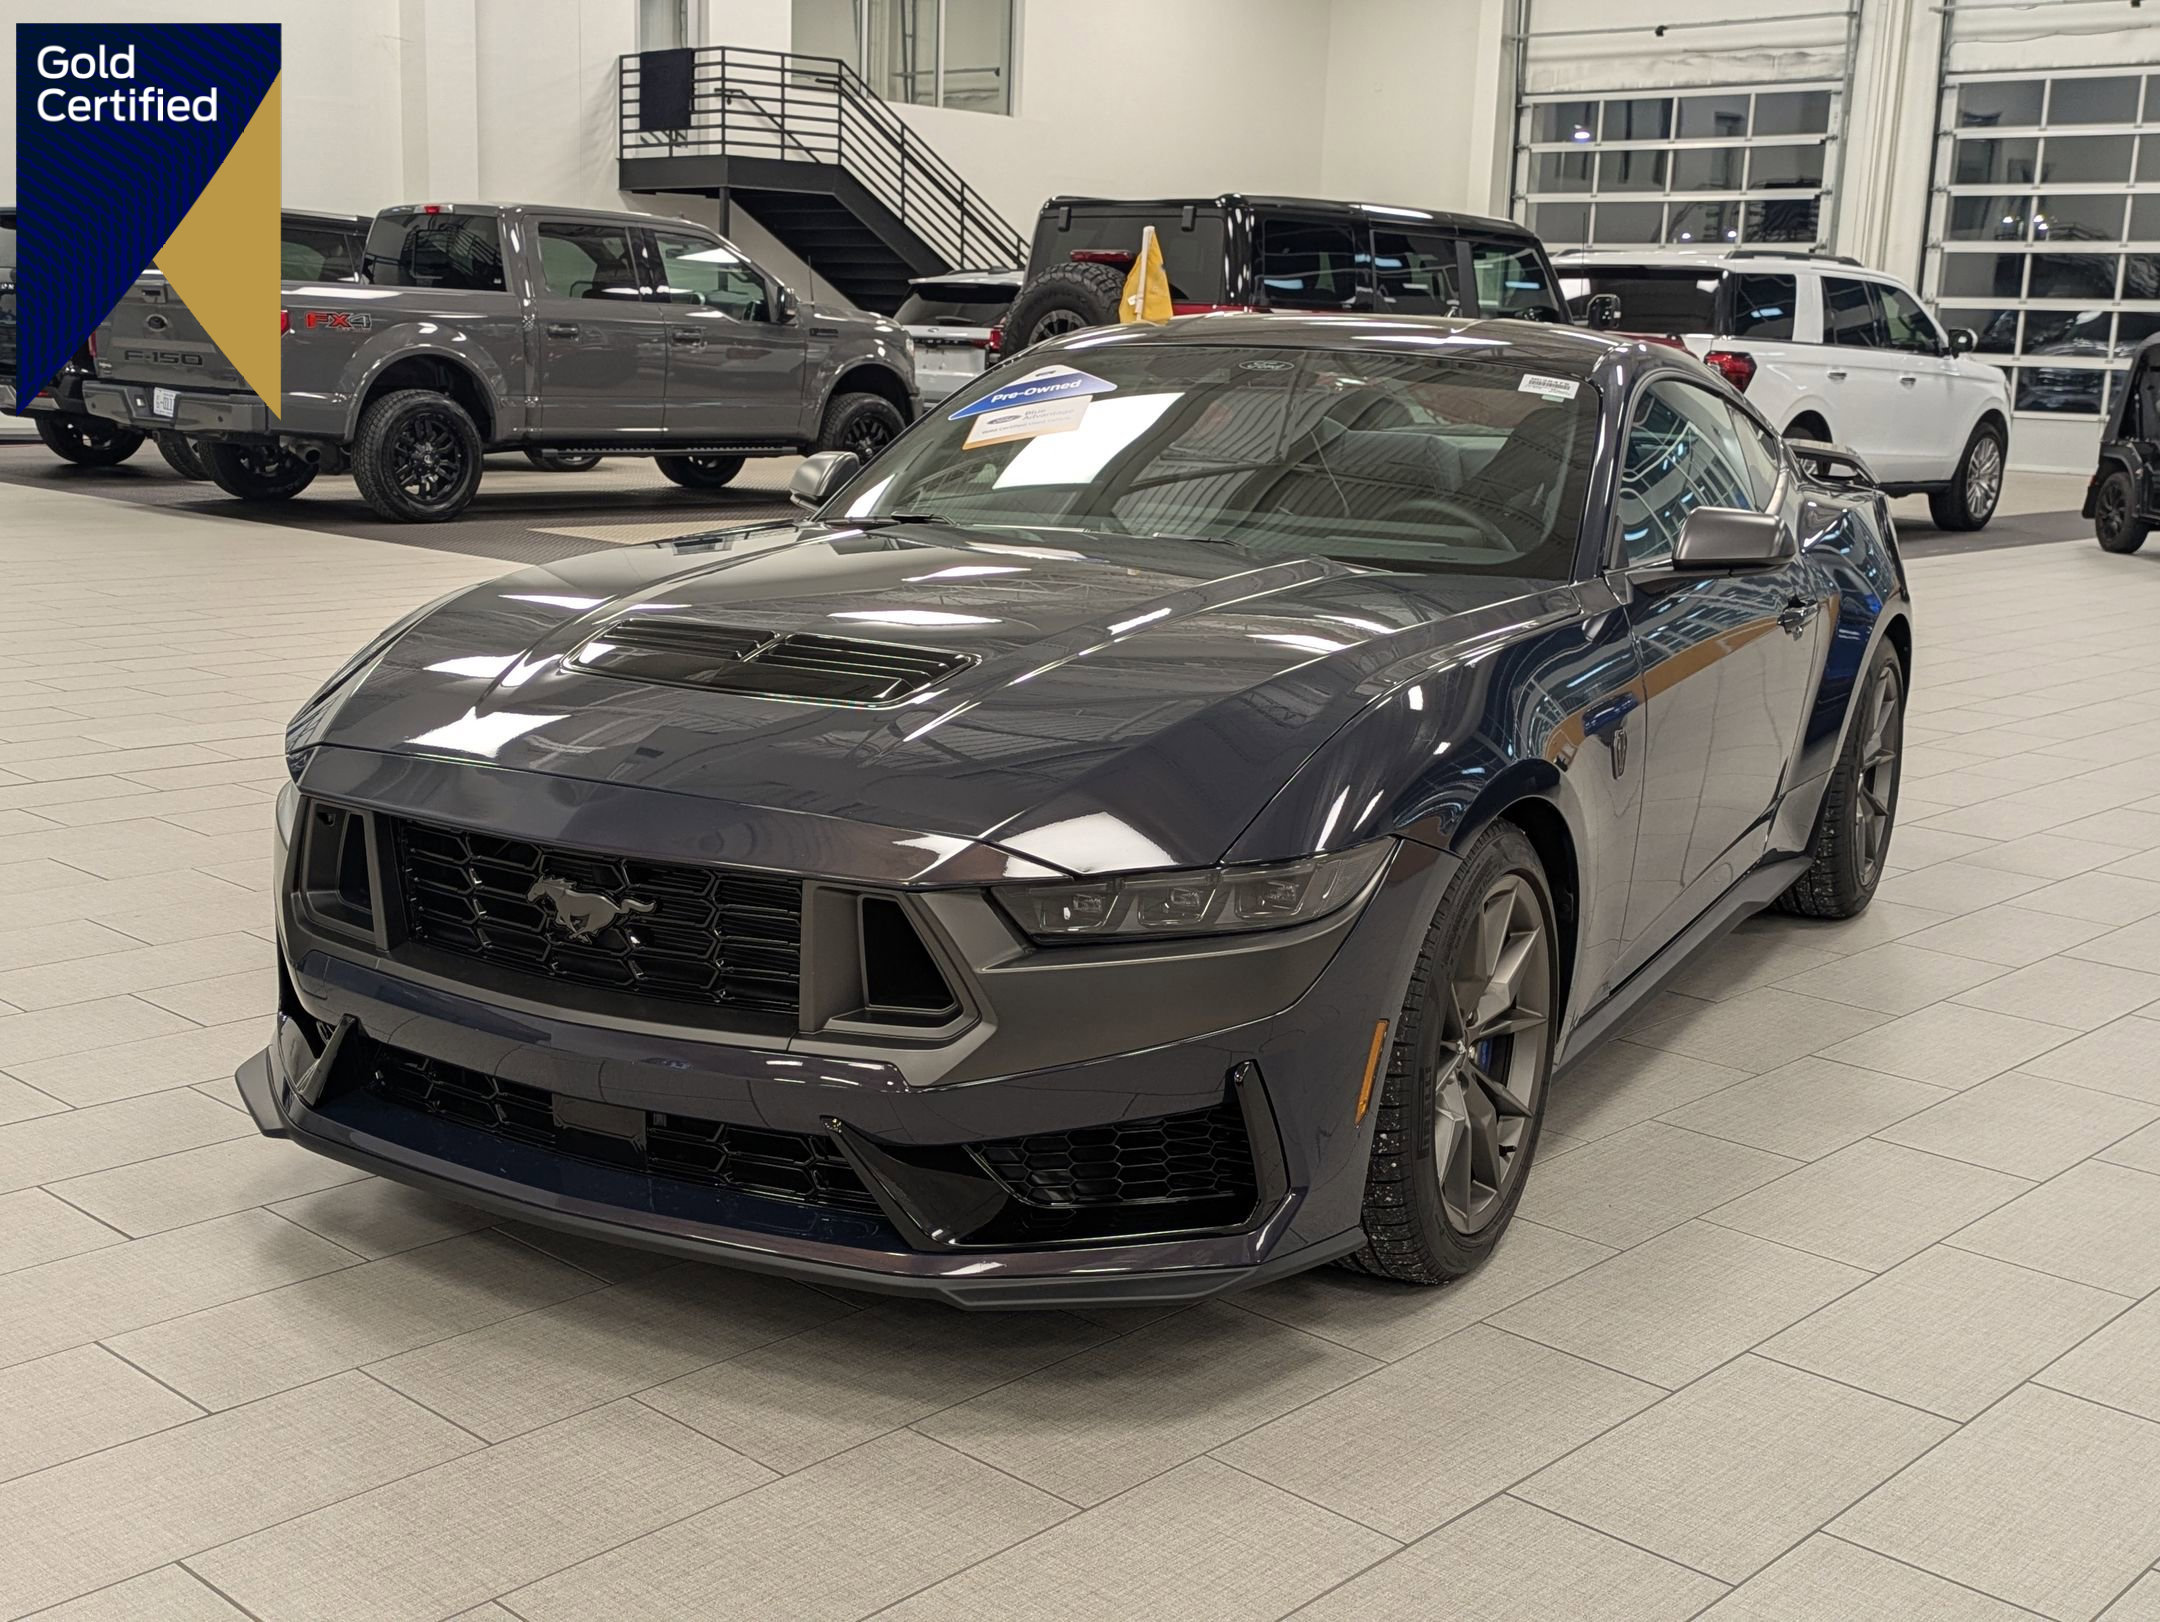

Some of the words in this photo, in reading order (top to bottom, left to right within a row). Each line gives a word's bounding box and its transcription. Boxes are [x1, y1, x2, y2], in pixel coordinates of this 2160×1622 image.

[305, 311, 372, 329] FX4
[124, 350, 203, 366] F-150
[990, 379, 1083, 404] Pre-Owned
